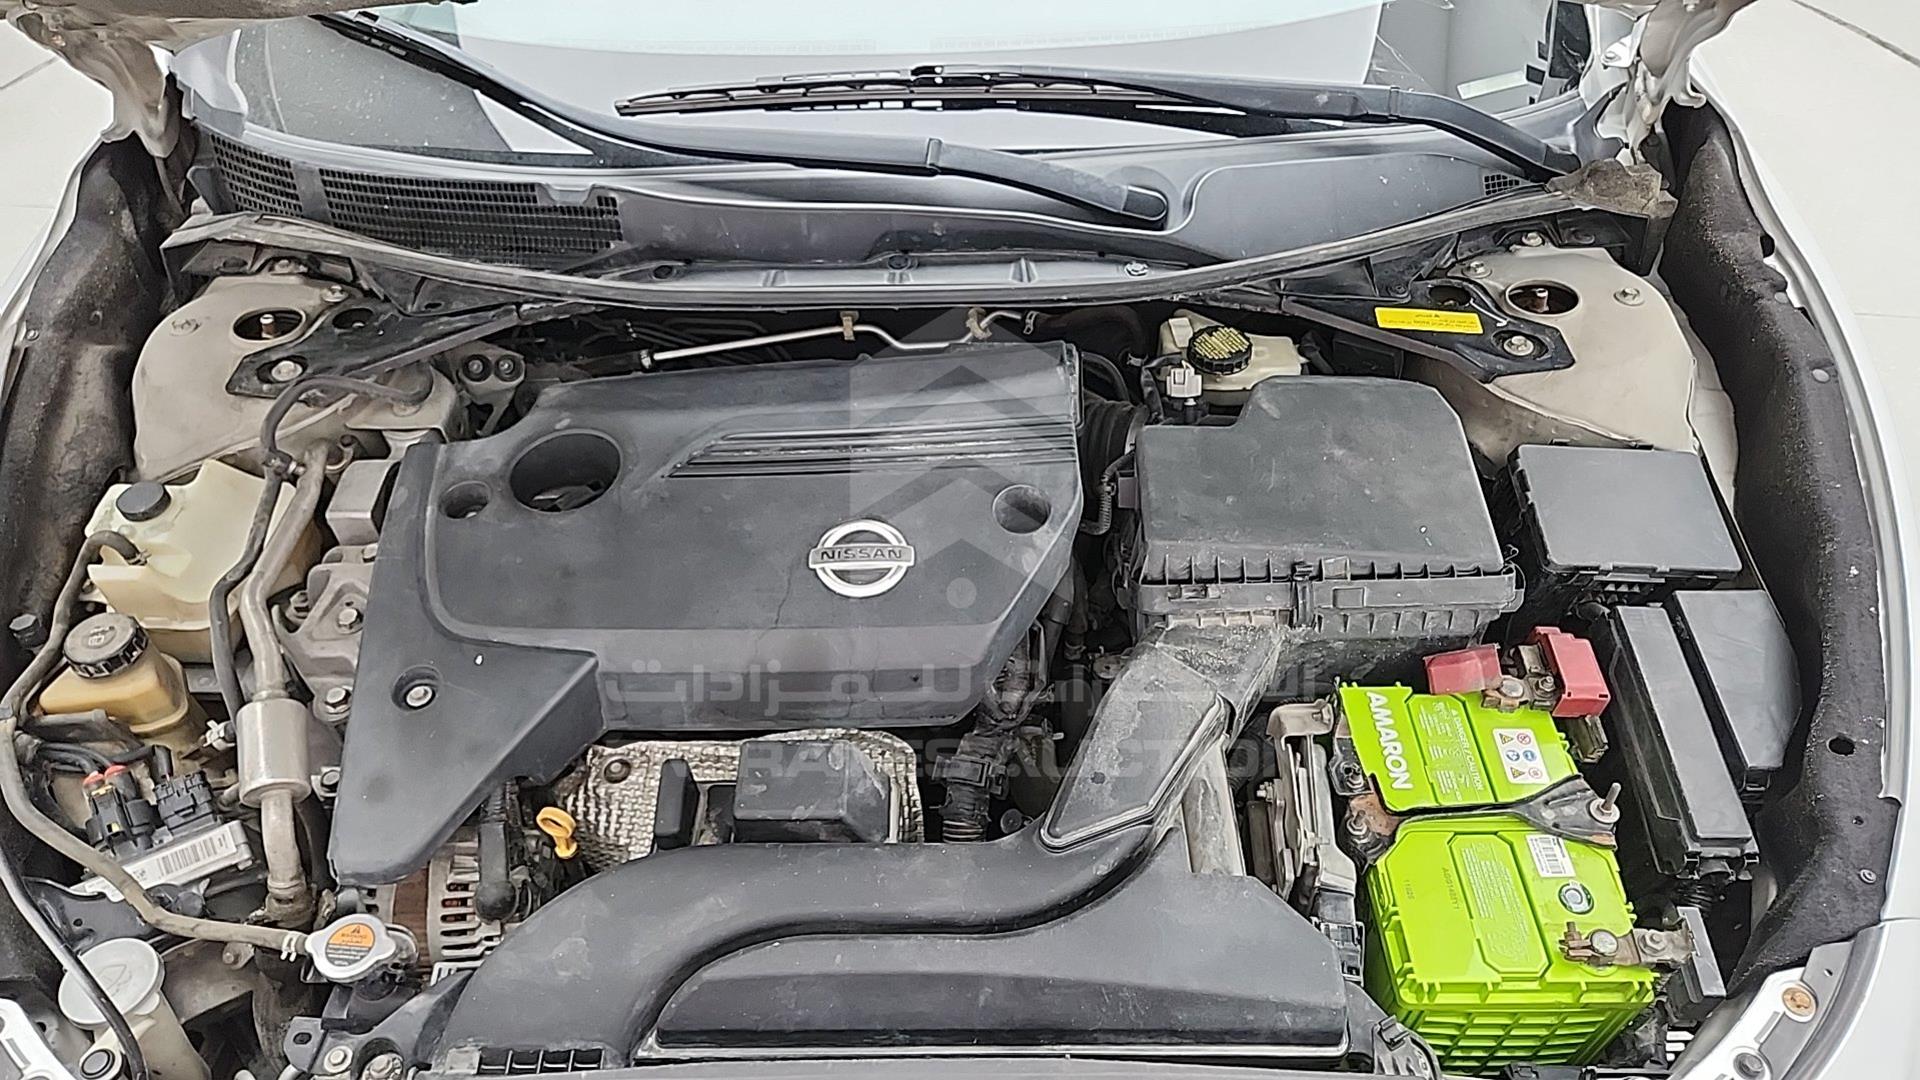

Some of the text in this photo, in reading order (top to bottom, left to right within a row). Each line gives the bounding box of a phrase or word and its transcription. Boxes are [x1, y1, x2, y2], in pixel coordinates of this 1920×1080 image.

[821, 548, 903, 560] NISSAN
[1366, 691, 1414, 790] AMARON
[1465, 755, 1484, 790] CAUTION
